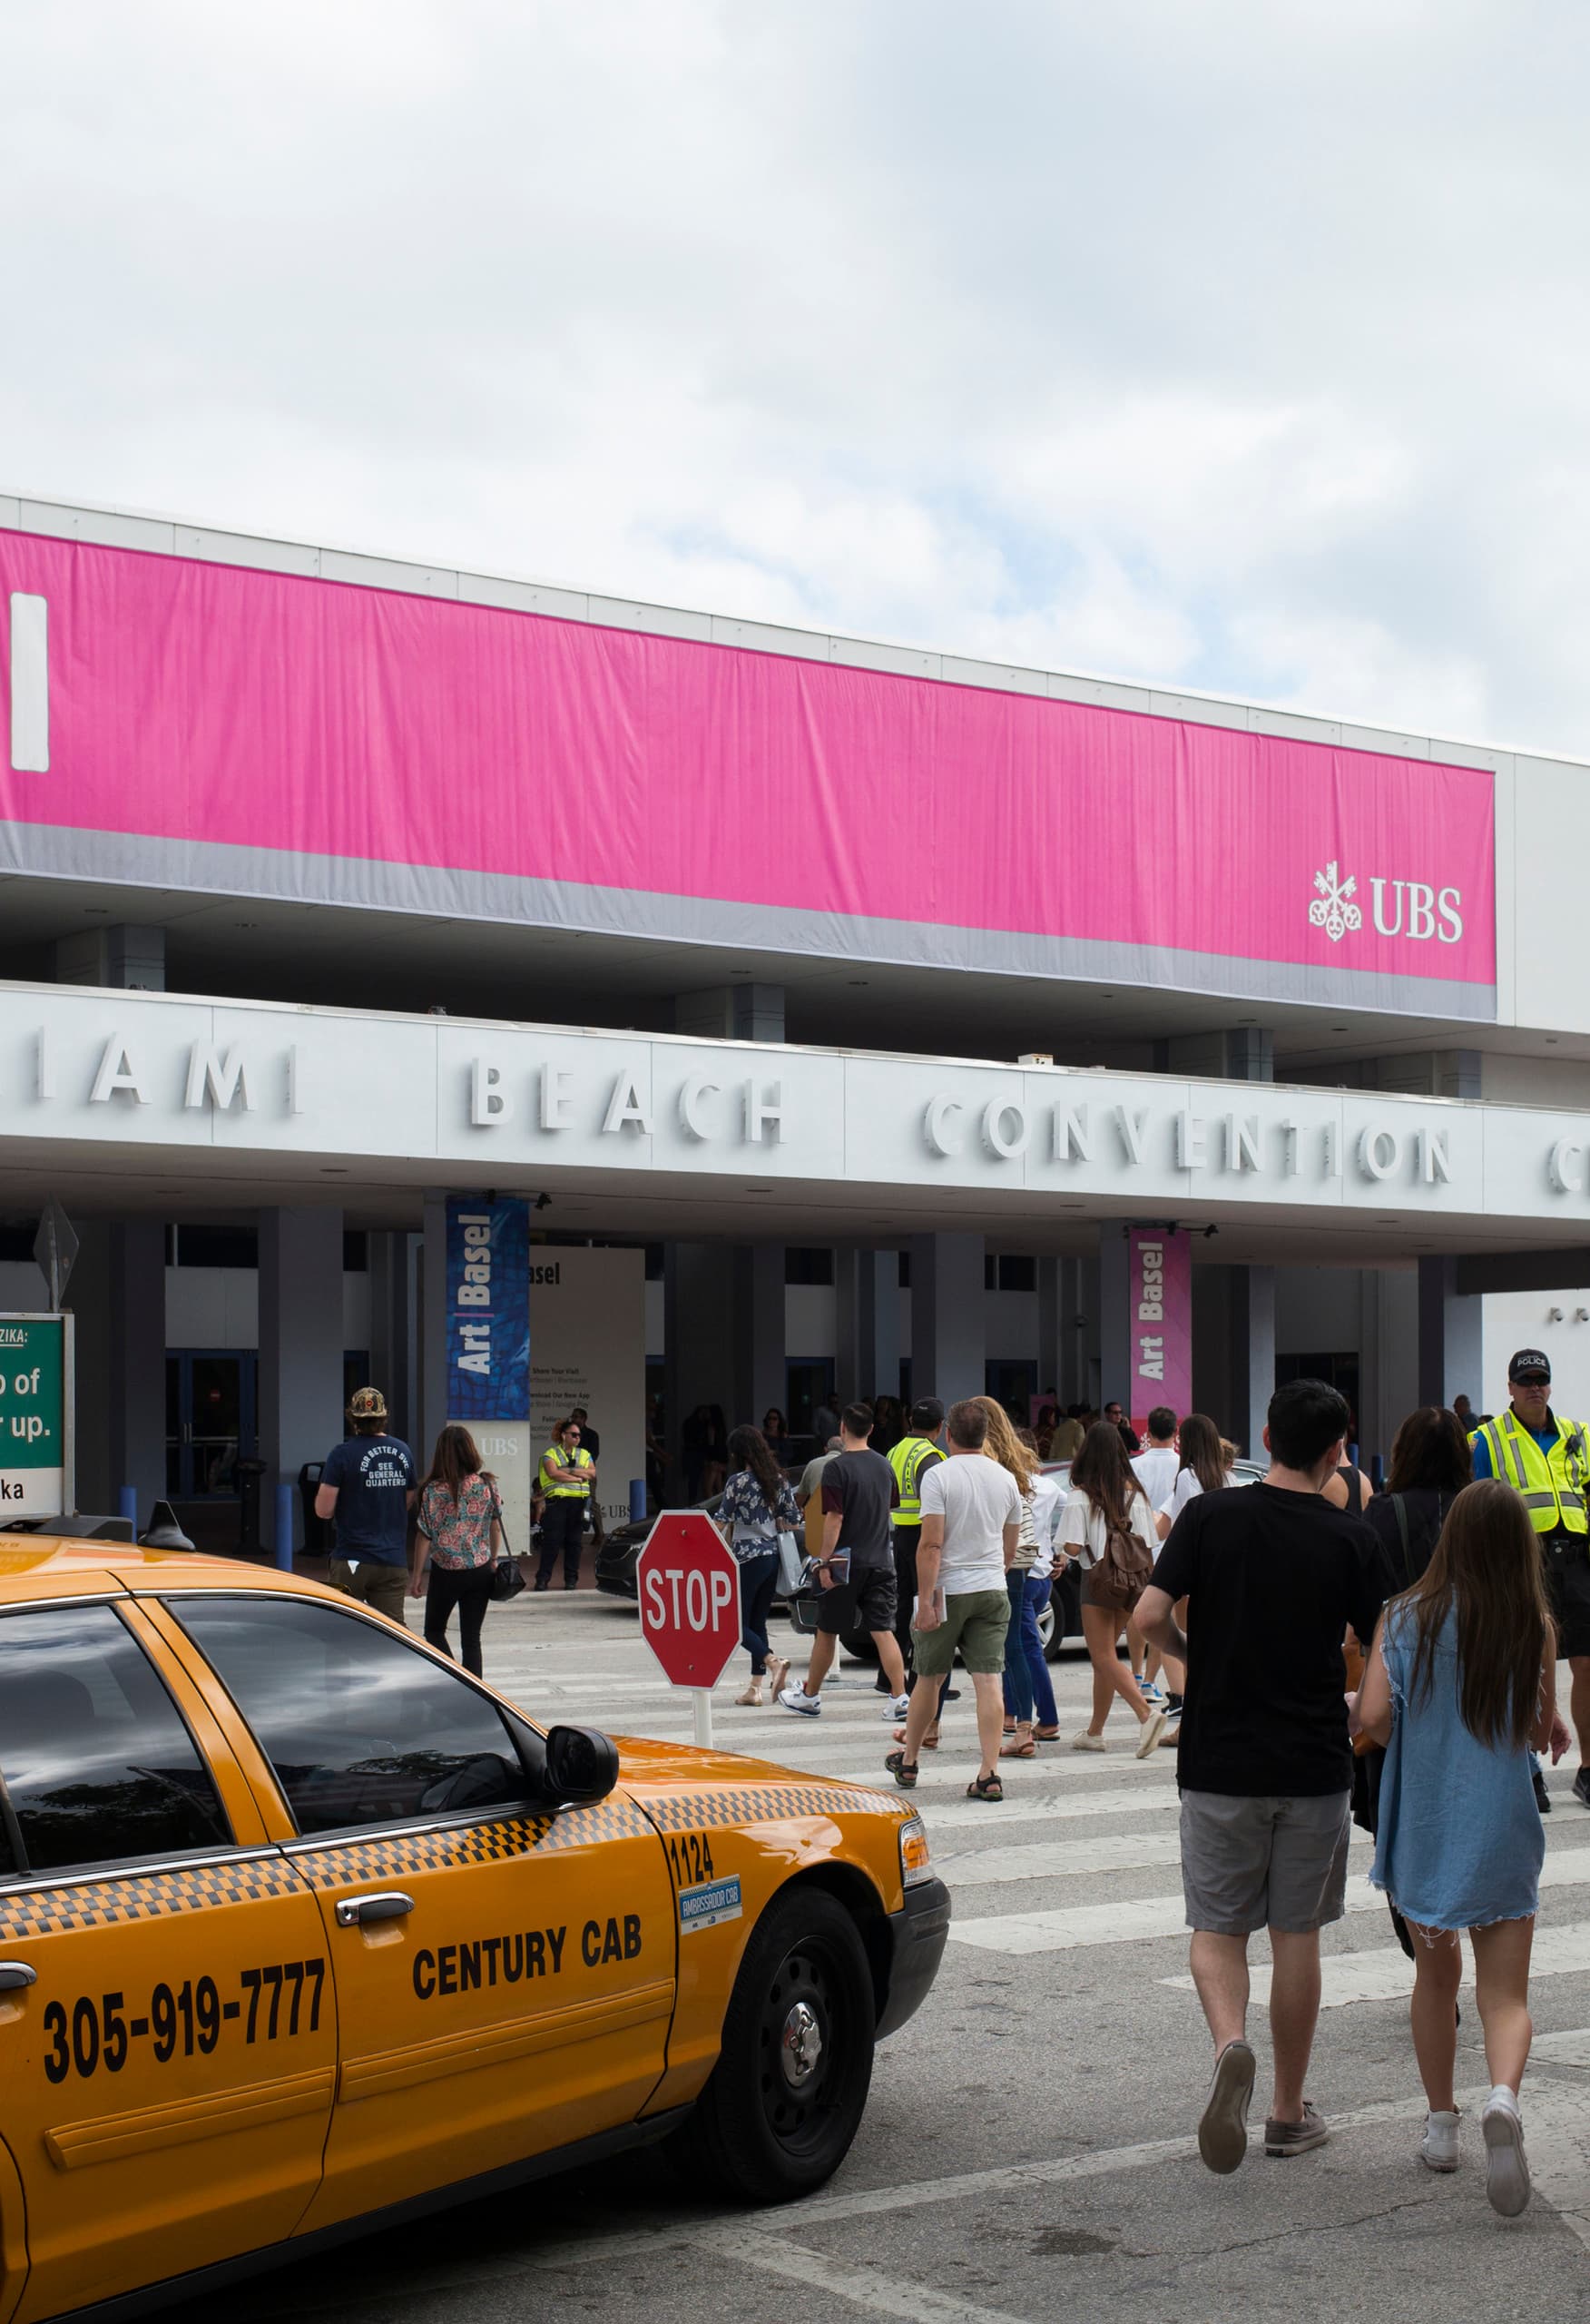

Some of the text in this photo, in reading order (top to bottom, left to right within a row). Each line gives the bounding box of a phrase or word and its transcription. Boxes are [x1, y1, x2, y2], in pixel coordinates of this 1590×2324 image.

[1369, 877, 1463, 943] UBS
[34, 1025, 305, 1116] IAMI
[471, 1056, 788, 1144] BEACH
[923, 1092, 1452, 1184] CONVENTION
[457, 1214, 491, 1374] Art Basel
[1137, 1242, 1163, 1381] Art Basel
[1517, 1357, 1546, 1367] POLICE
[15, 1367, 41, 1394] of
[11, 1416, 51, 1443] up.
[360, 1455, 371, 1472] FOR
[368, 1445, 398, 1459] BETTER
[480, 1437, 518, 1456] UBS
[368, 1470, 405, 1480] GENERAL
[378, 1462, 394, 1471] SEE
[365, 1478, 407, 1488] QUARTERS
[645, 1569, 731, 1631] STOP
[671, 1833, 713, 1886] 1124
[682, 1886, 739, 1917] AMBASSADOR CAB
[413, 1914, 642, 2000] CENTURY CAB
[44, 1958, 325, 2083] 305-919-7777
